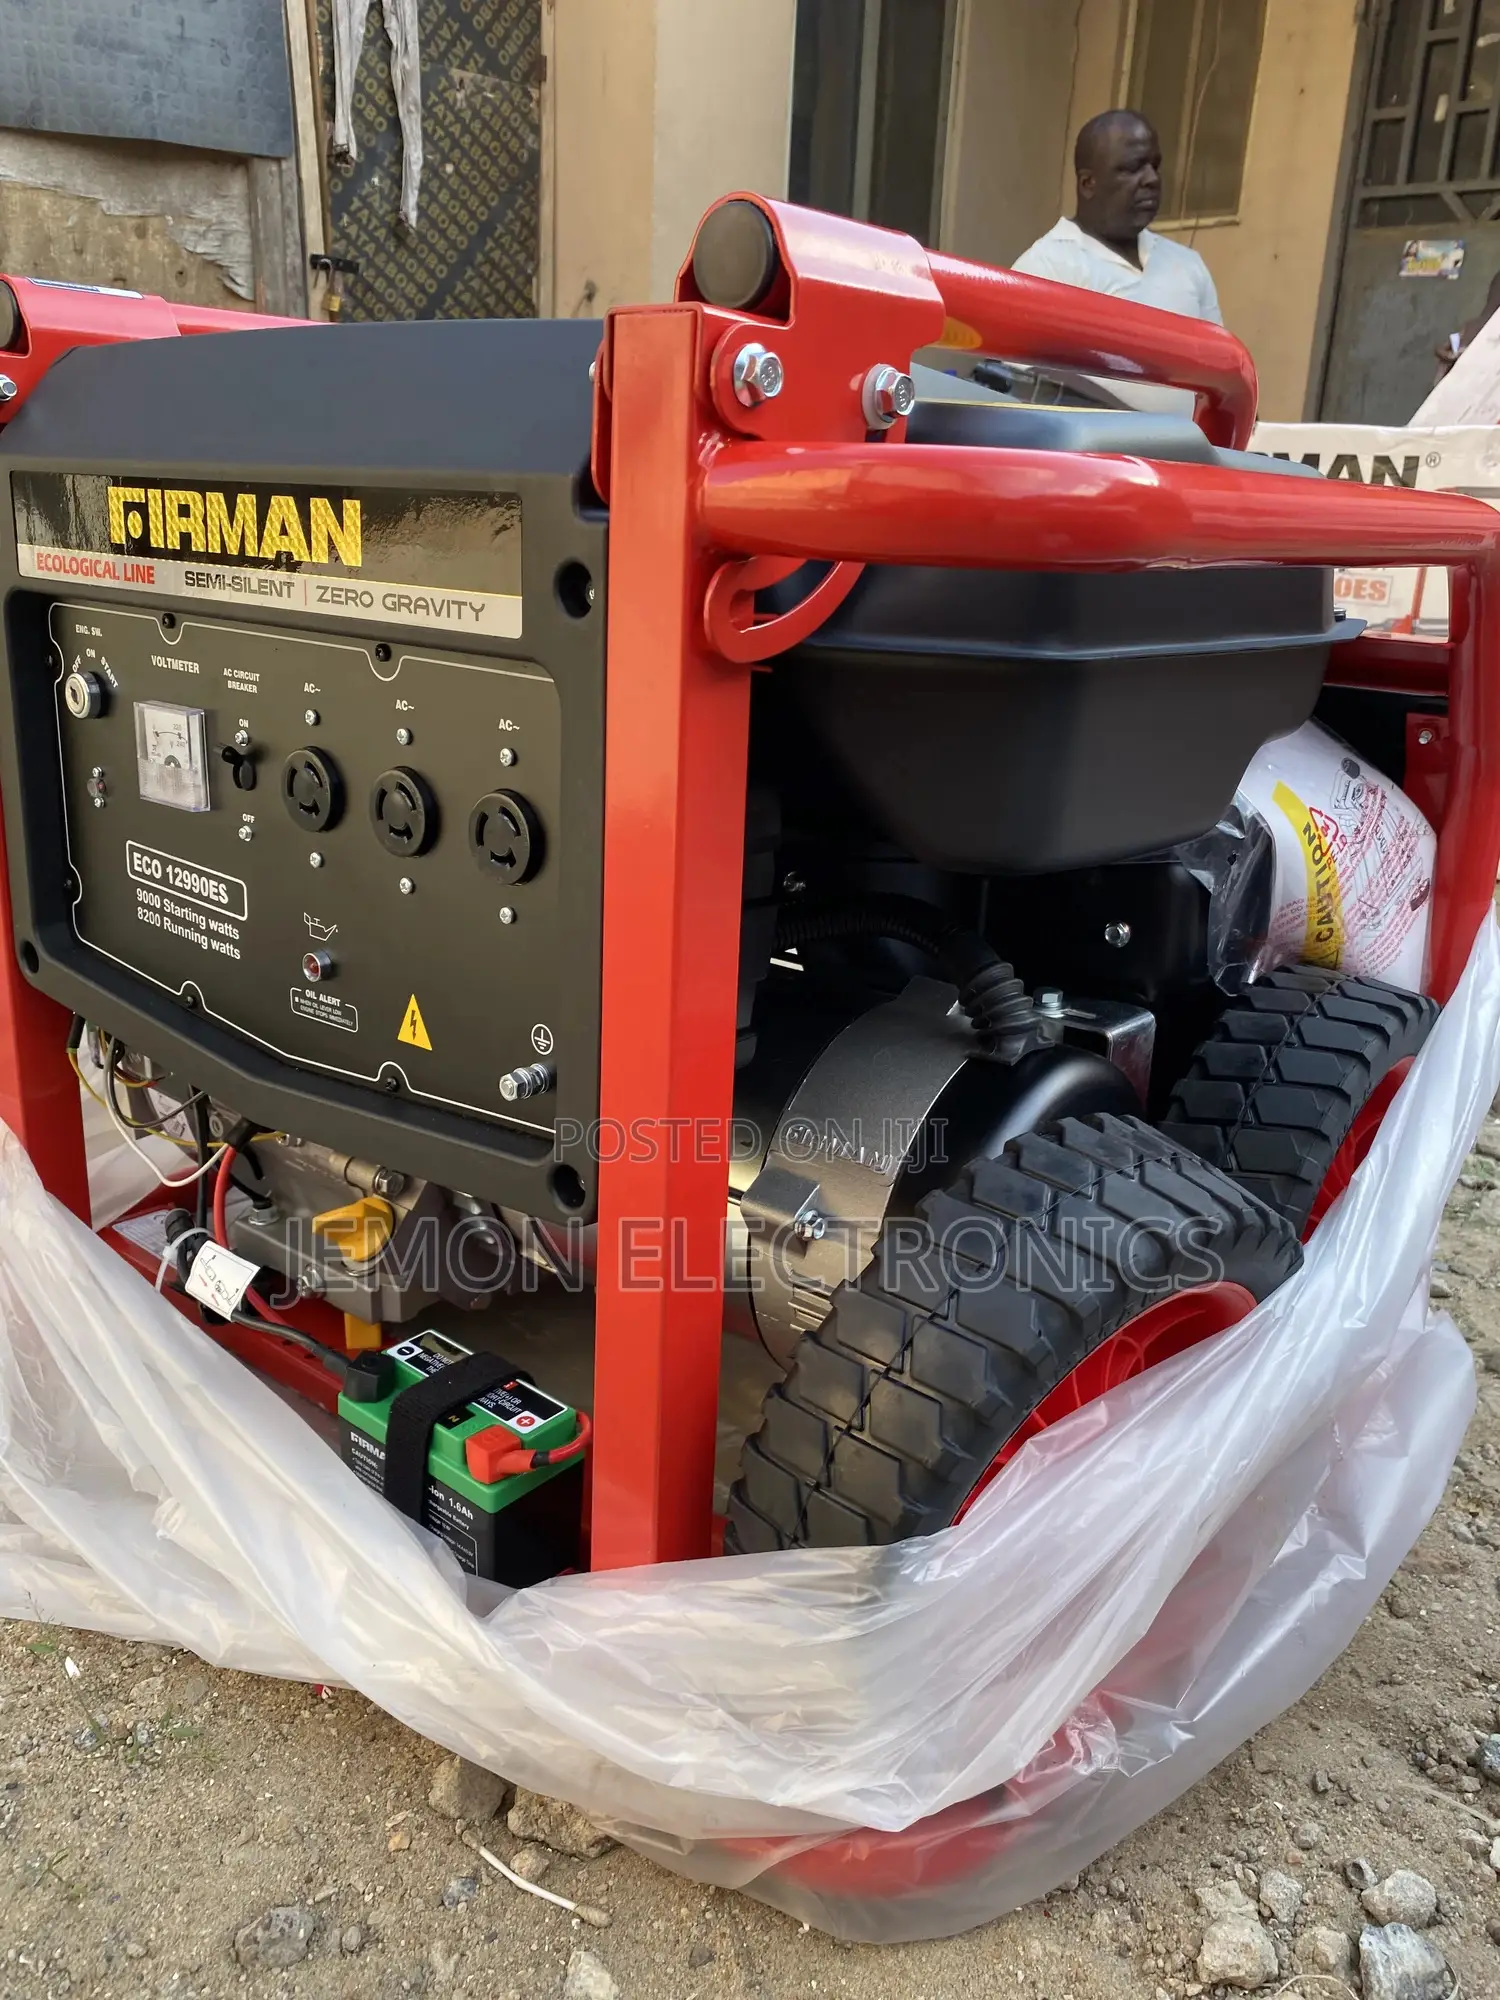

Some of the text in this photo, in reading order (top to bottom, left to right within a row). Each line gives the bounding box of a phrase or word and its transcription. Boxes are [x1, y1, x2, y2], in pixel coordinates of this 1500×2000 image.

[107, 486, 362, 567] FIRMAN
[36, 552, 155, 585] ECOLOGICAL LINE
[184, 570, 486, 622] SEMI-SILENT ZERO GRAVITY
[75, 624, 90, 635] ENG.
[72, 654, 82, 673] OFF
[85, 648, 96, 659] ON
[151, 654, 200, 675] VOLTMETER
[100, 656, 119, 688] START
[223, 668, 260, 683] AC CIRCUIT
[227, 681, 258, 694] BREAKER
[239, 718, 249, 728] ON
[242, 814, 255, 825] OFF
[133, 851, 229, 905] ECO 12990ES
[1302, 821, 1334, 943] CAUTION
[136, 887, 240, 940] 9000 Starting watts
[137, 906, 241, 960] 8200 Running watts
[305, 989, 341, 1007] OIL ALERT
[449, 1497, 474, 1521] 1.6Ah
